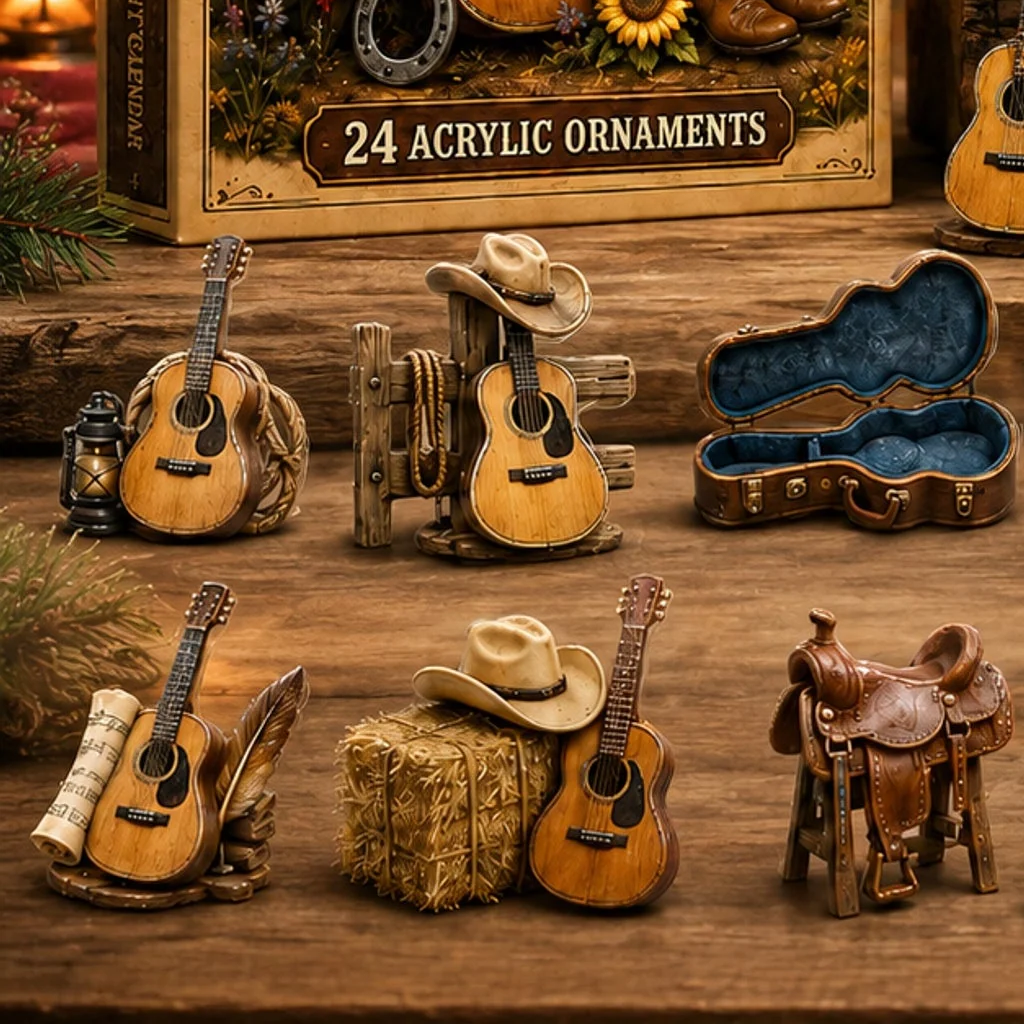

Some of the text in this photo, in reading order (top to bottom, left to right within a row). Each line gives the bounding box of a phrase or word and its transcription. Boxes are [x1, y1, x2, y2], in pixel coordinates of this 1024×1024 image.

[344, 111, 766, 166] 24 ACRYLIC ORNAMENTS
